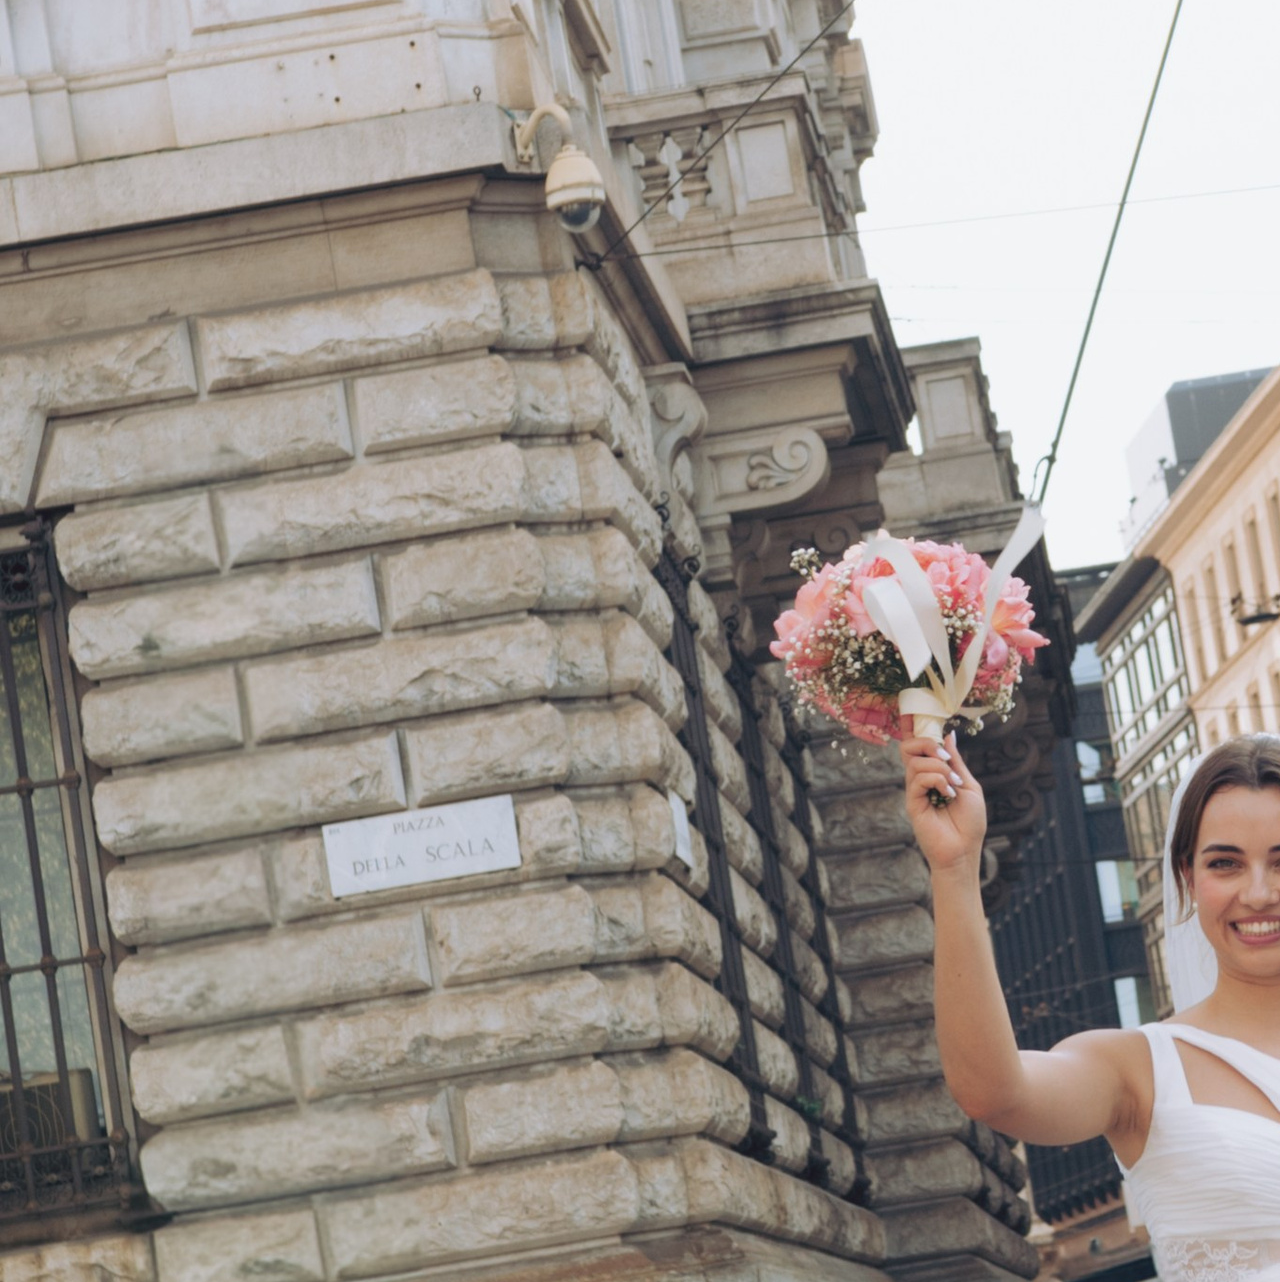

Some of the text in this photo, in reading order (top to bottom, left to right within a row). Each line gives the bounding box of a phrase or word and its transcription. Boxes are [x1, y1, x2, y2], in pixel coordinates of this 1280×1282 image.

[393, 816, 445, 835] PIAZZA
[353, 838, 494, 876] DELLA SCALA
